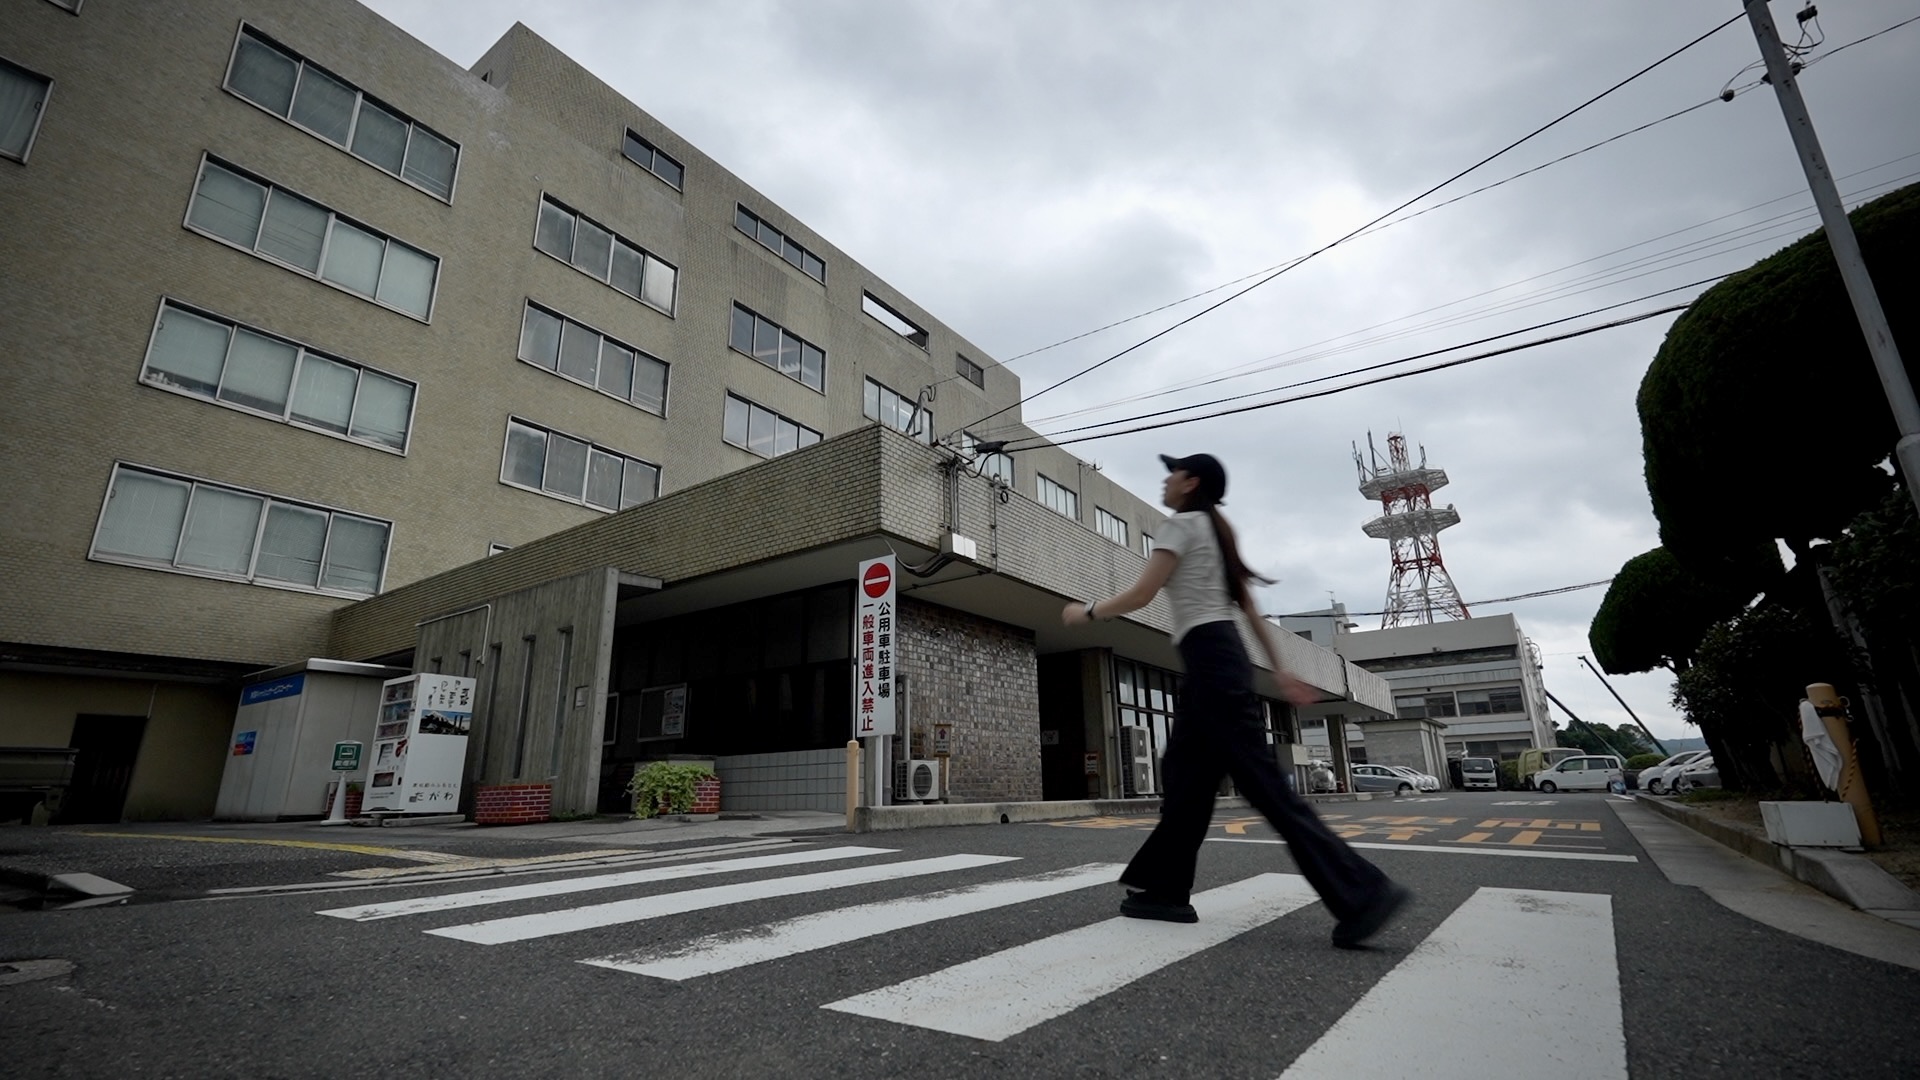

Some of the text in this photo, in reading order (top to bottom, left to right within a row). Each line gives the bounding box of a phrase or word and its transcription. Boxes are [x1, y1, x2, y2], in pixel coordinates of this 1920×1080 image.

[861, 602, 874, 732] 一般車両進入禁止
[878, 602, 891, 698] 公用車駐車場
